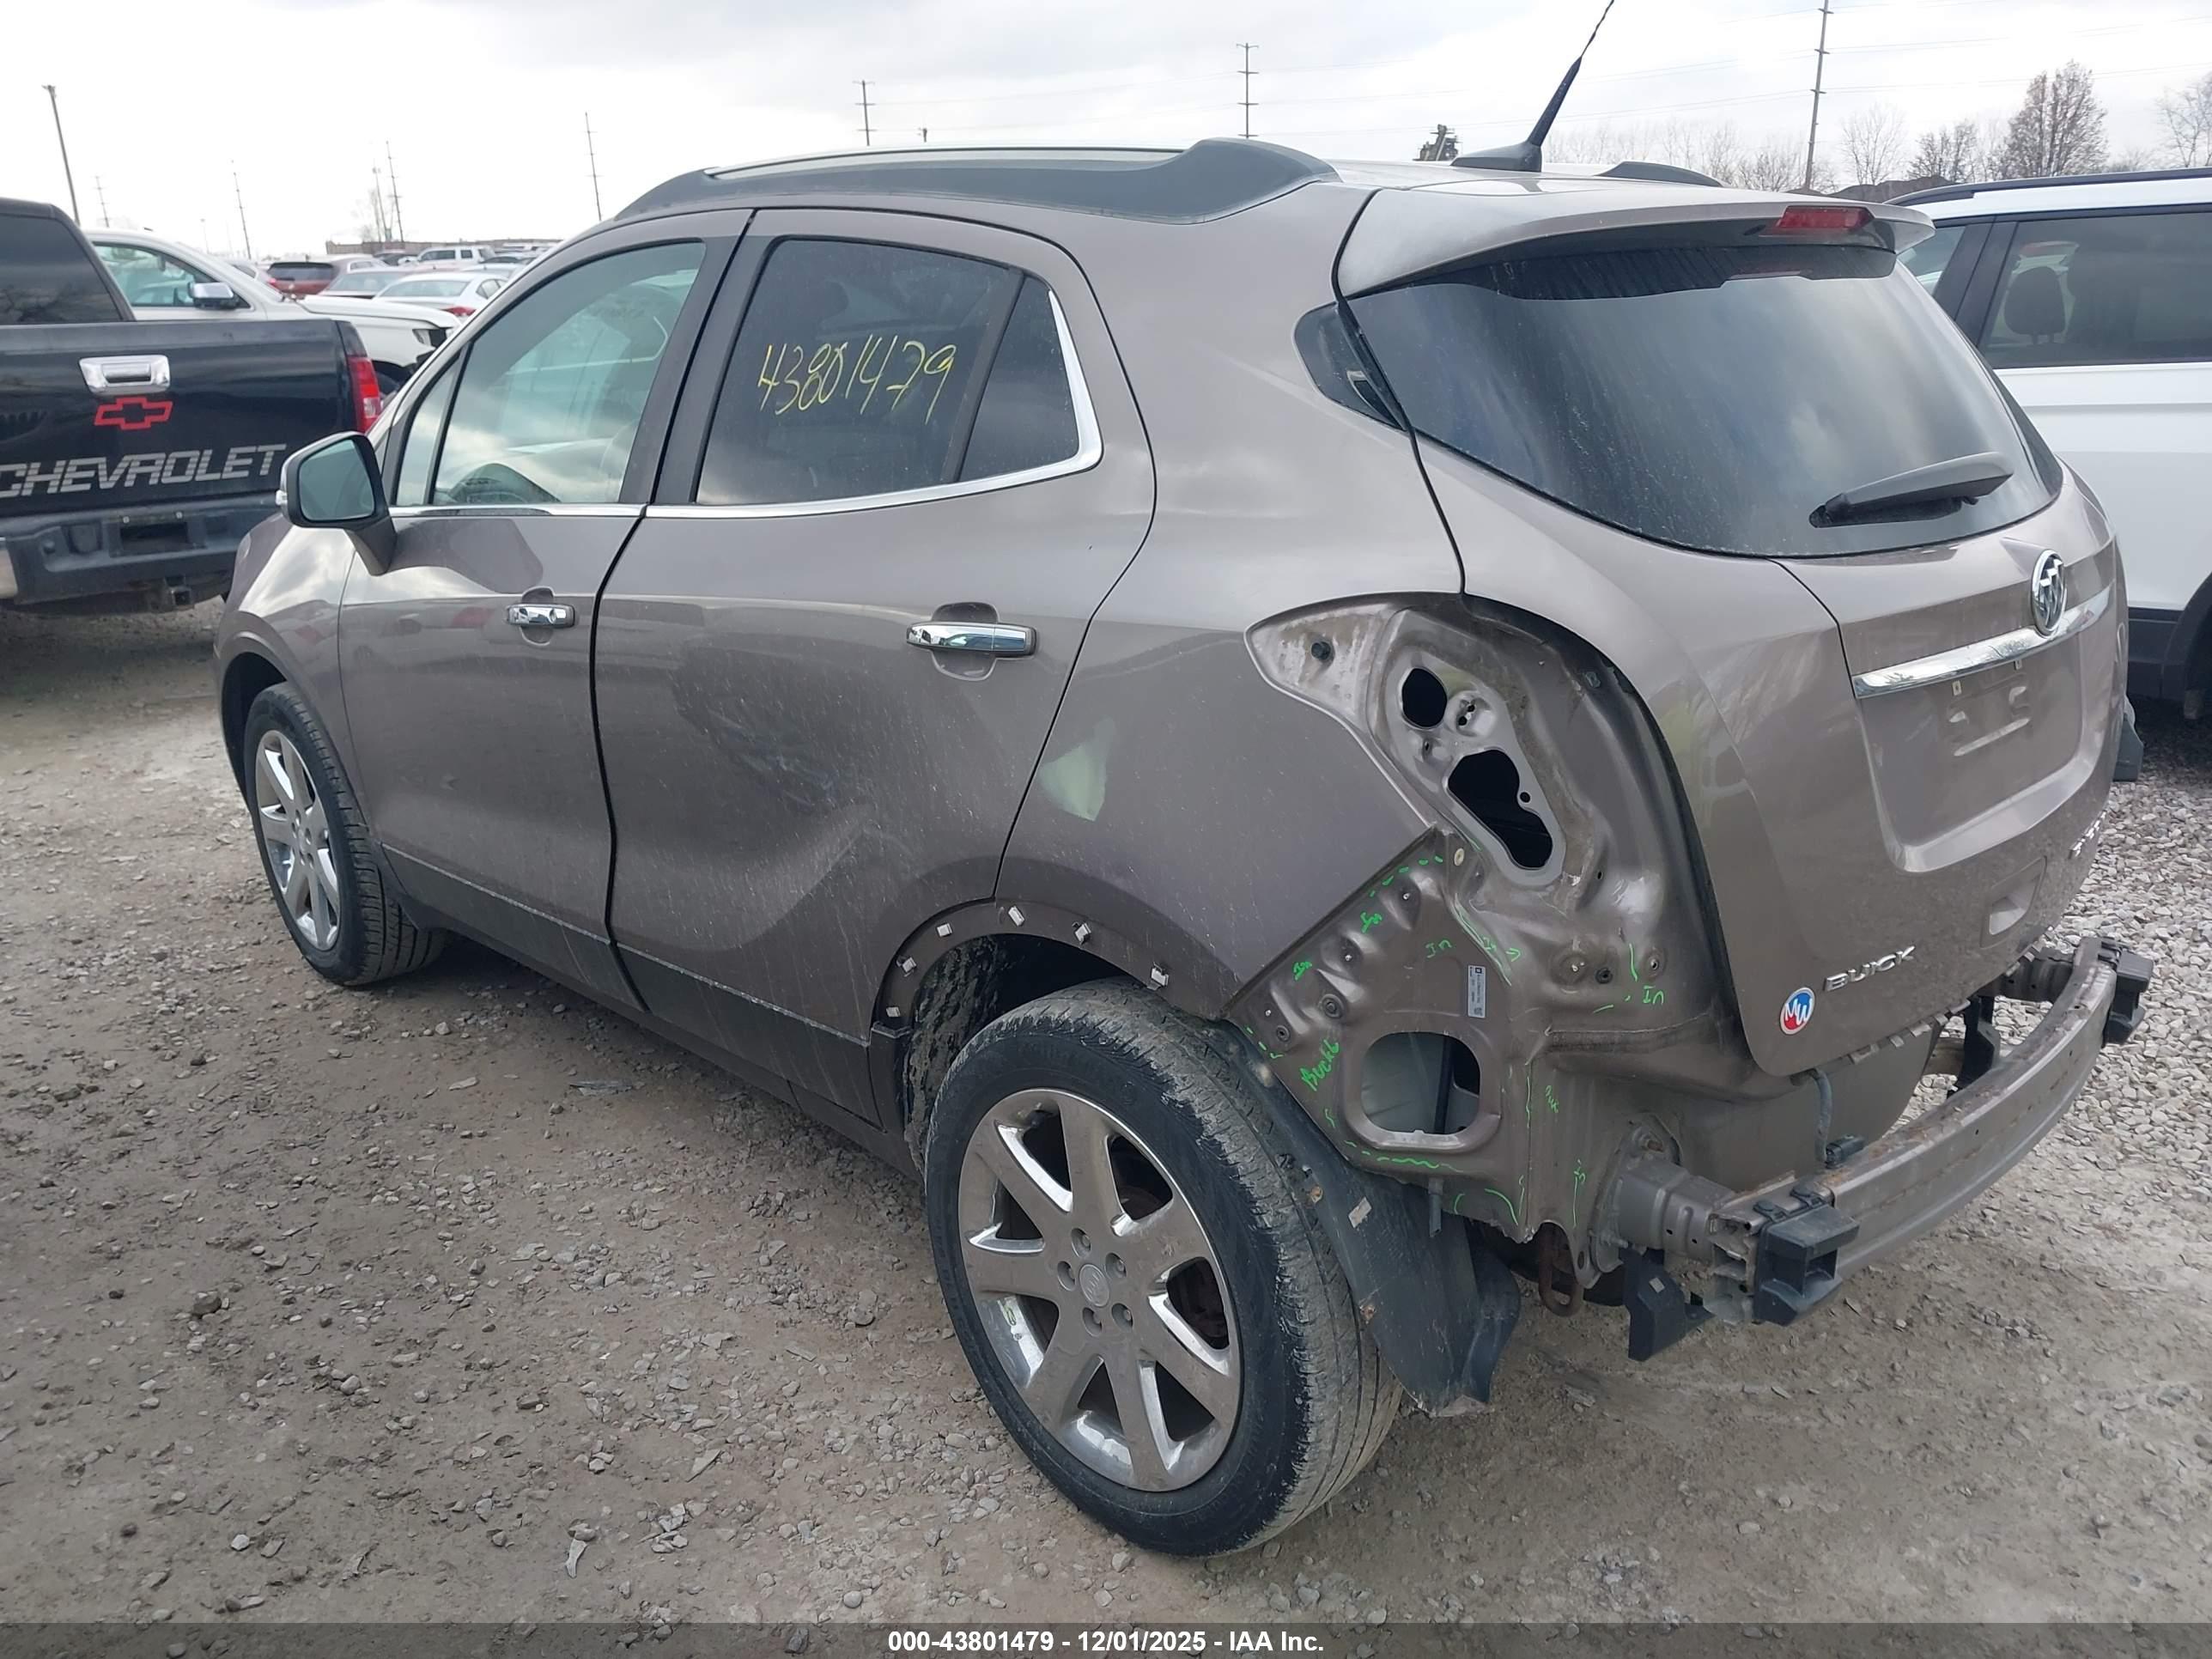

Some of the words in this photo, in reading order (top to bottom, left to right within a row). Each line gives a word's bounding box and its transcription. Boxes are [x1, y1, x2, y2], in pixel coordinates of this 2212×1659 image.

[757, 333, 957, 425] 43801479
[0, 443, 287, 498] CHEVROLET
[1823, 945, 1916, 991] BUICK
